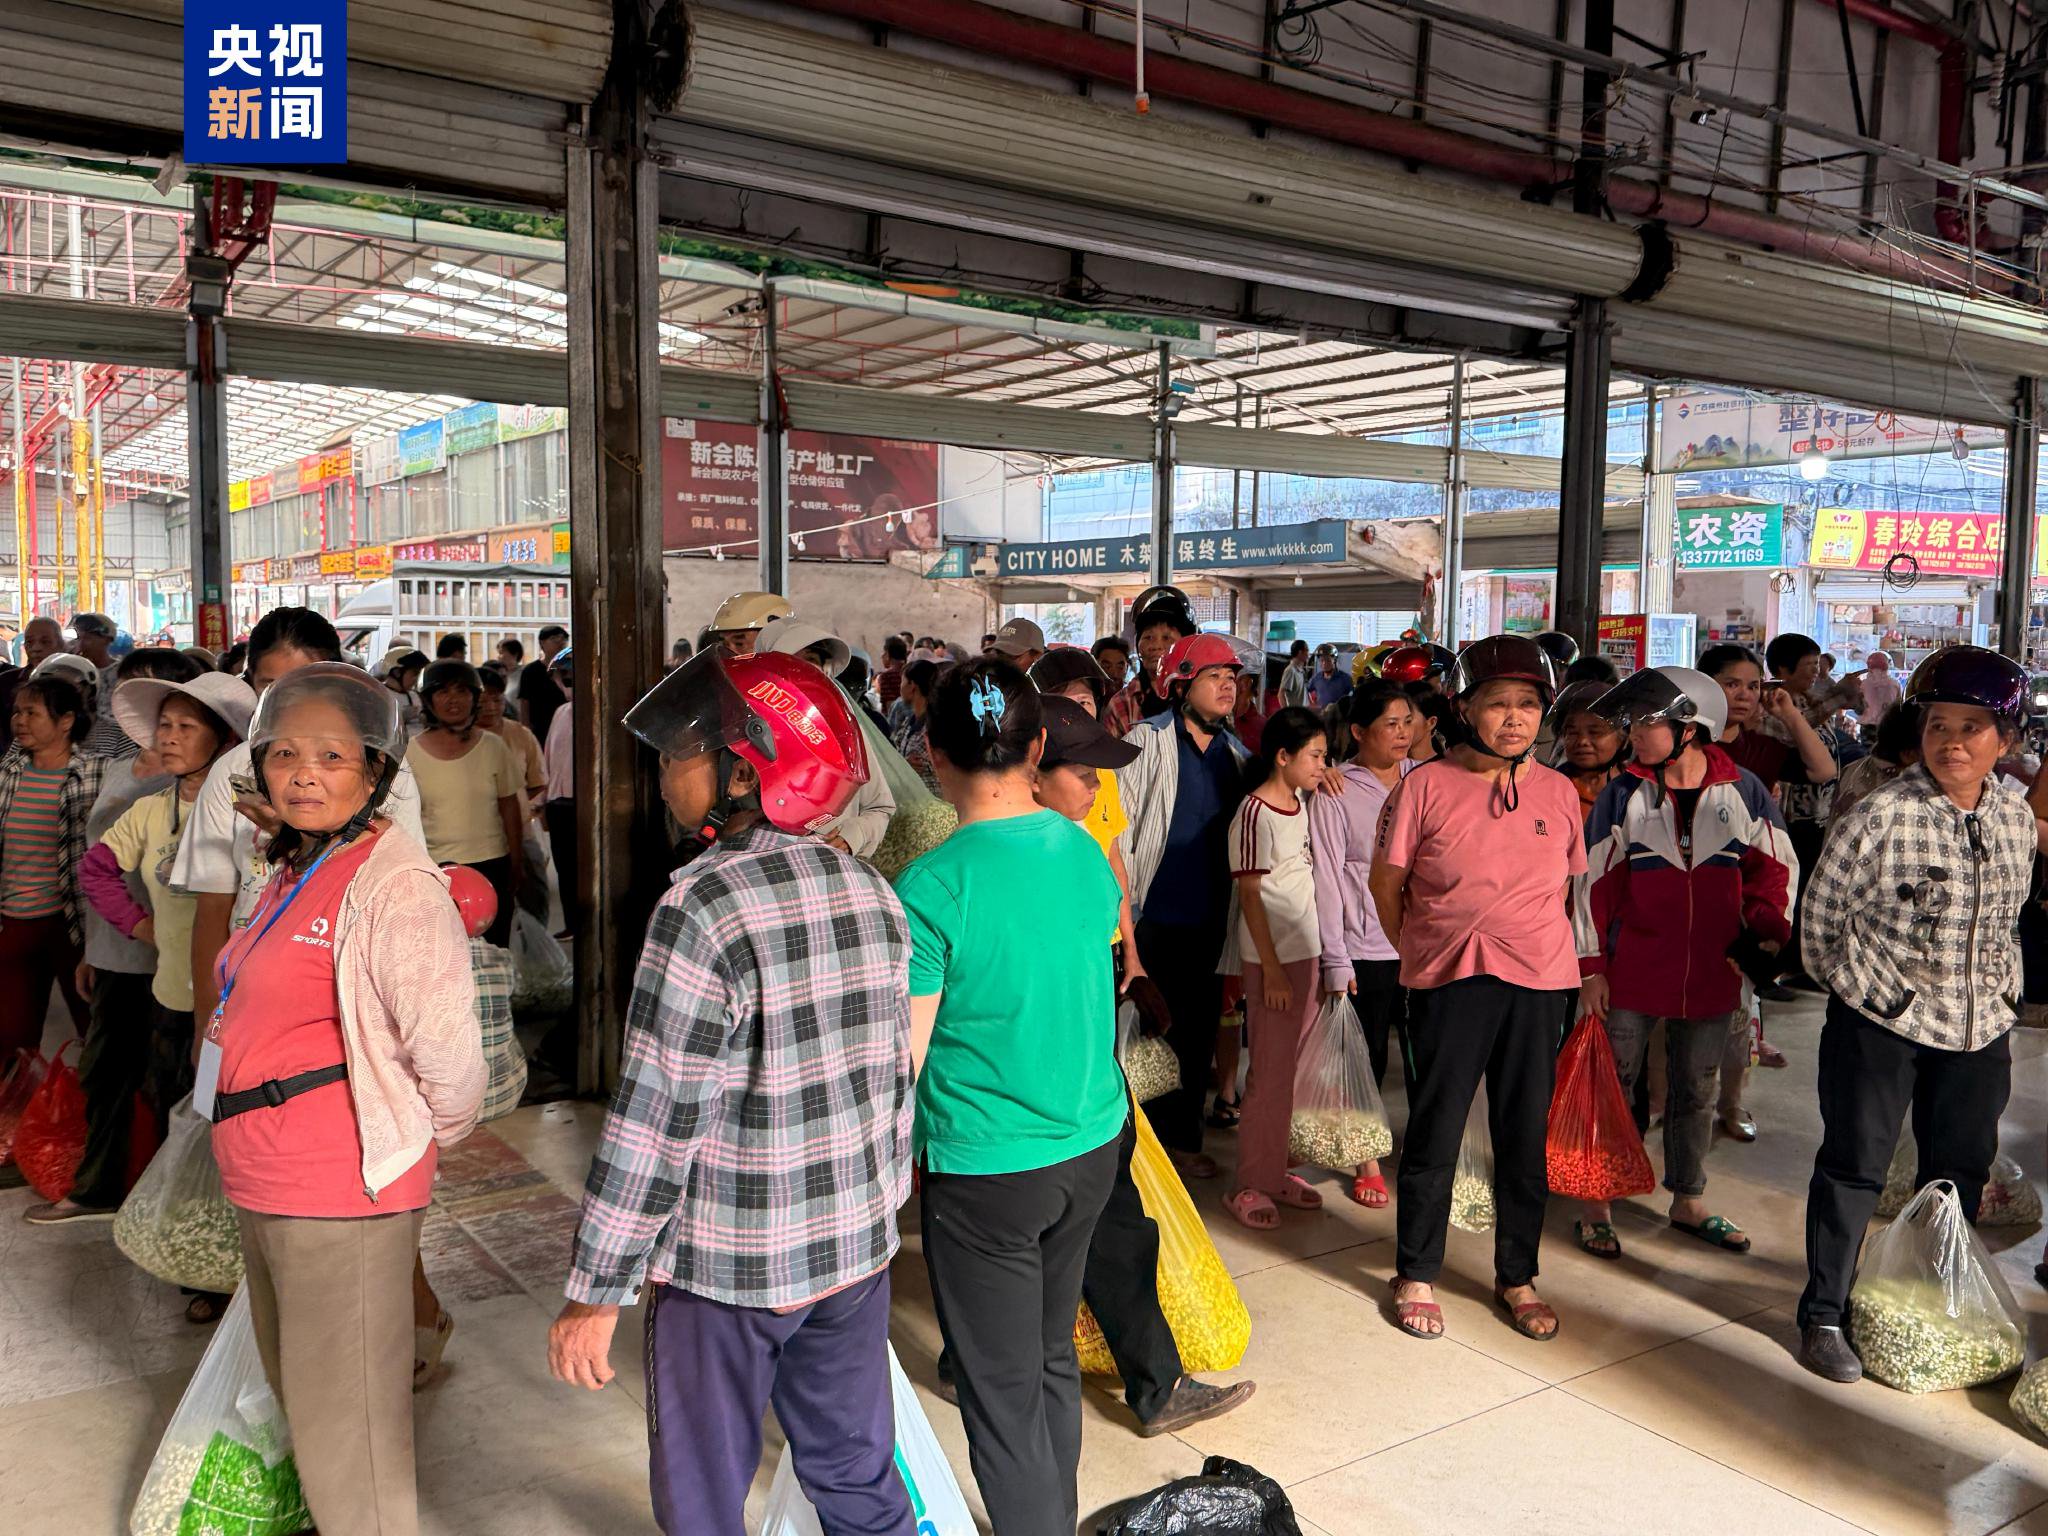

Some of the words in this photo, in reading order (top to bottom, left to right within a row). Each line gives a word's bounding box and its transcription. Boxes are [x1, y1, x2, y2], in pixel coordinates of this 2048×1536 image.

[690, 441, 874, 476] 新会陈产地工厂
[1873, 516, 2005, 550] 春玲综合店
[1007, 550, 1047, 571] CITY
[1052, 547, 1106, 568] HOME
[1120, 536, 1238, 566] 木架保终生
[1681, 549, 1764, 564] 13377121169
